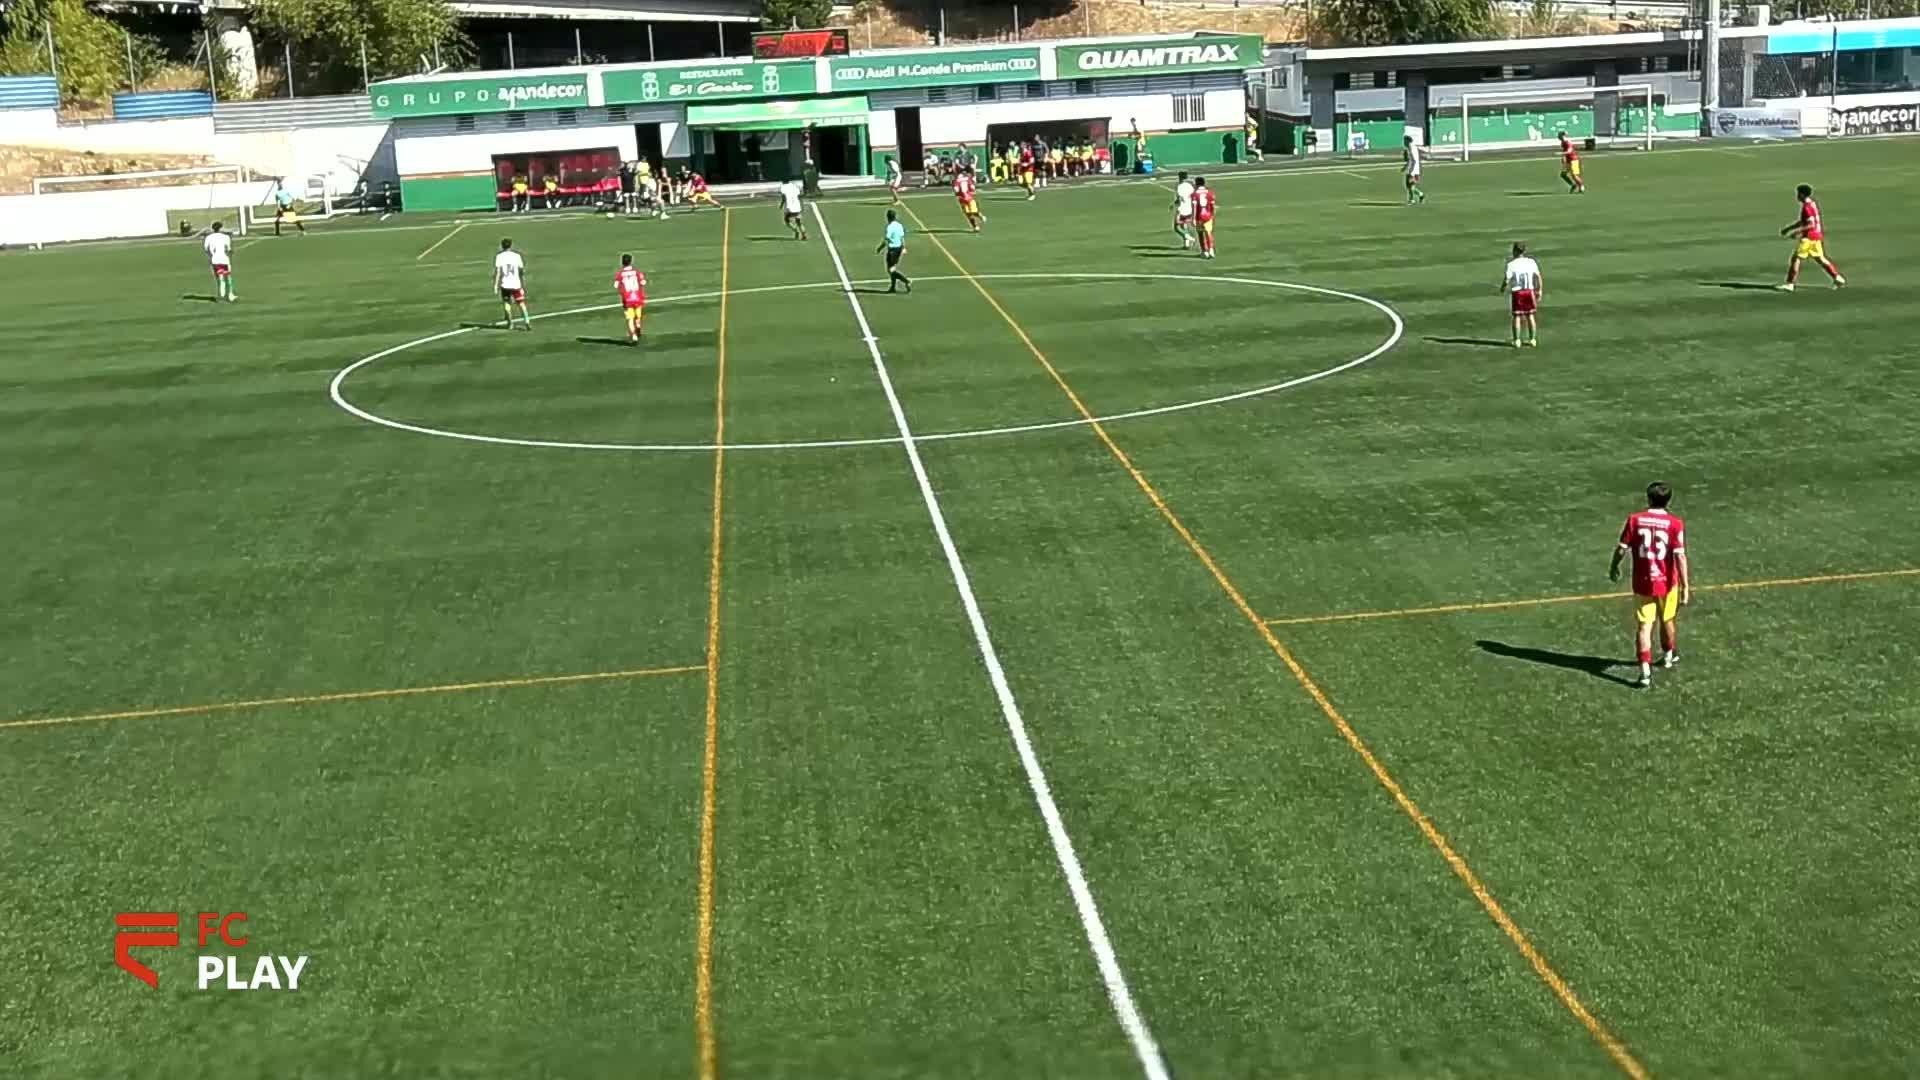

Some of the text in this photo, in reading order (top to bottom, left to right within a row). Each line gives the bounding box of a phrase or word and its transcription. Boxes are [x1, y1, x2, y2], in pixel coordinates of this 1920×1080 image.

[1078, 44, 1240, 70] QUAMTRAX
[866, 65, 895, 79] Audi
[952, 60, 1008, 74] Premium
[376, 89, 489, 107] GRUPO
[1638, 528, 1669, 560] 23
